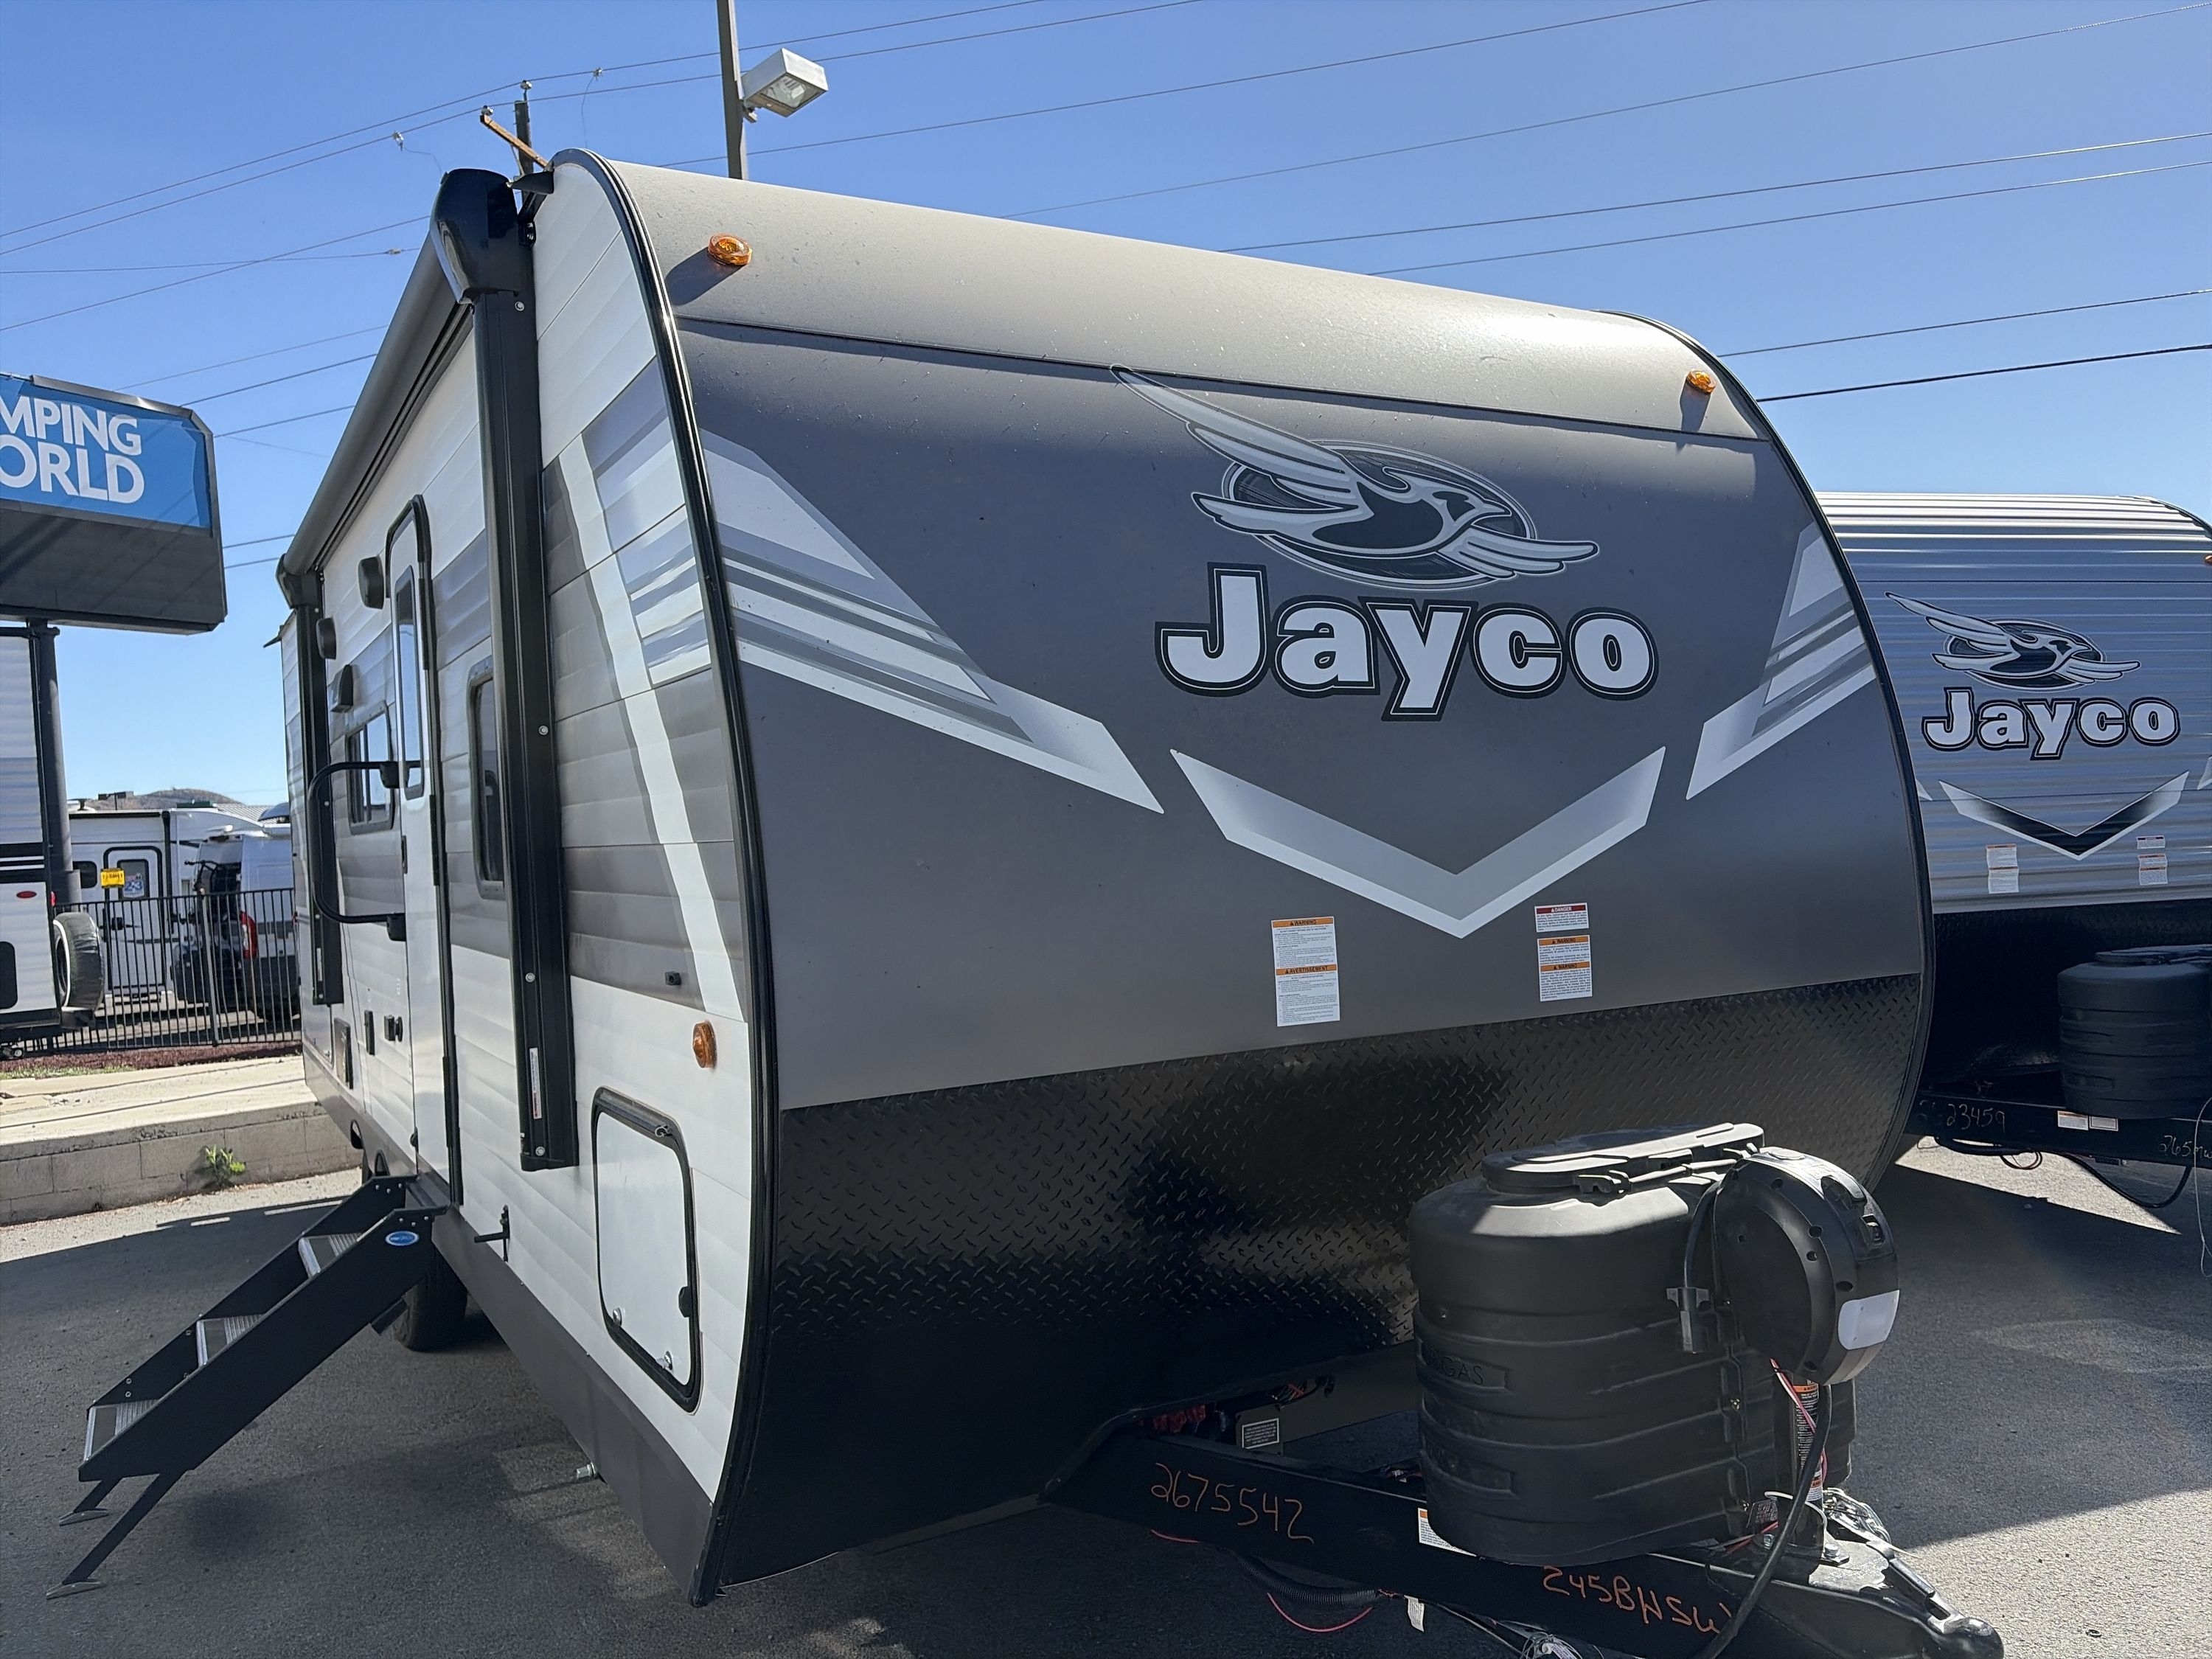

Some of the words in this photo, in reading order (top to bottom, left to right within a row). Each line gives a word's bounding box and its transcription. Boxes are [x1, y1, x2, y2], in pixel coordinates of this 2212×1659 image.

[0, 434, 145, 504] ORLD
[1155, 562, 1659, 721] Jayco
[1921, 686, 2180, 760] Jayco
[1289, 965, 1328, 974] AVERTISSEMENT
[1441, 1355, 1484, 1385] GAS
[1151, 1462, 1315, 1544] 2675542
